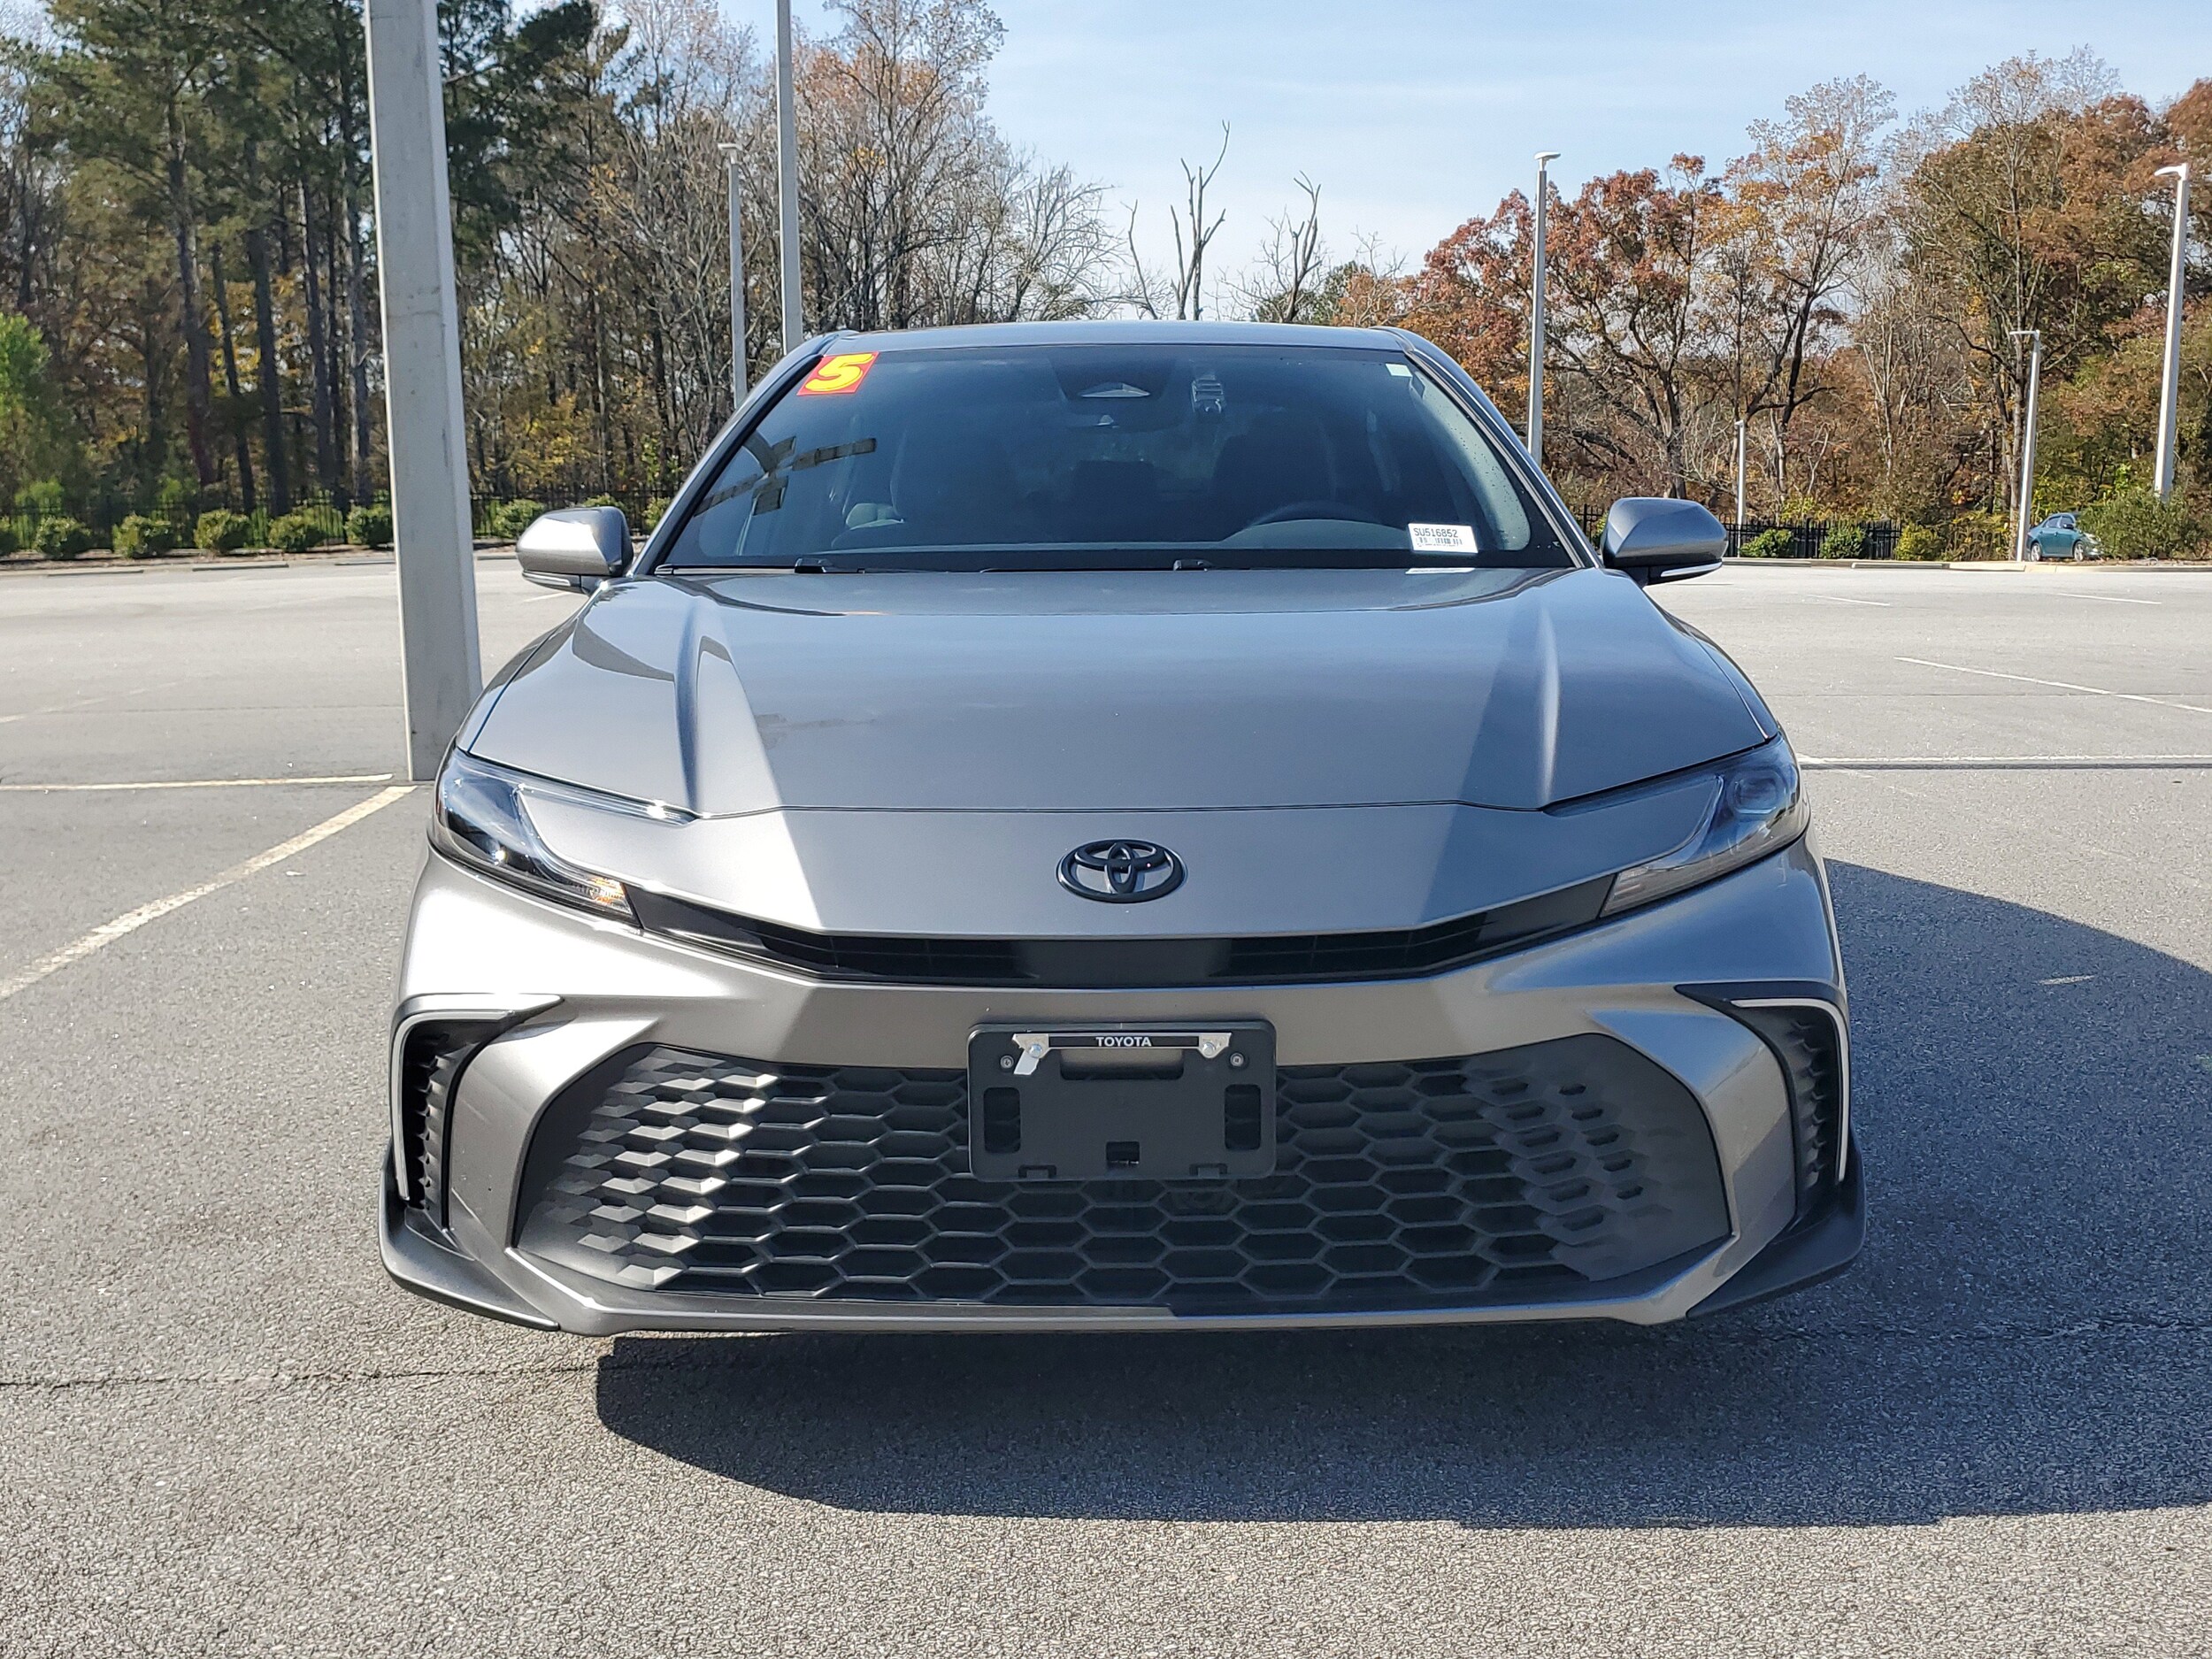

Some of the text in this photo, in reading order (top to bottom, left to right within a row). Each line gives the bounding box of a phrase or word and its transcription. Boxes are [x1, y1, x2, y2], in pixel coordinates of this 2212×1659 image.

[804, 354, 875, 392] 5
[1413, 527, 1459, 538] SU516852
[1095, 1036, 1152, 1048] TOYOTA
